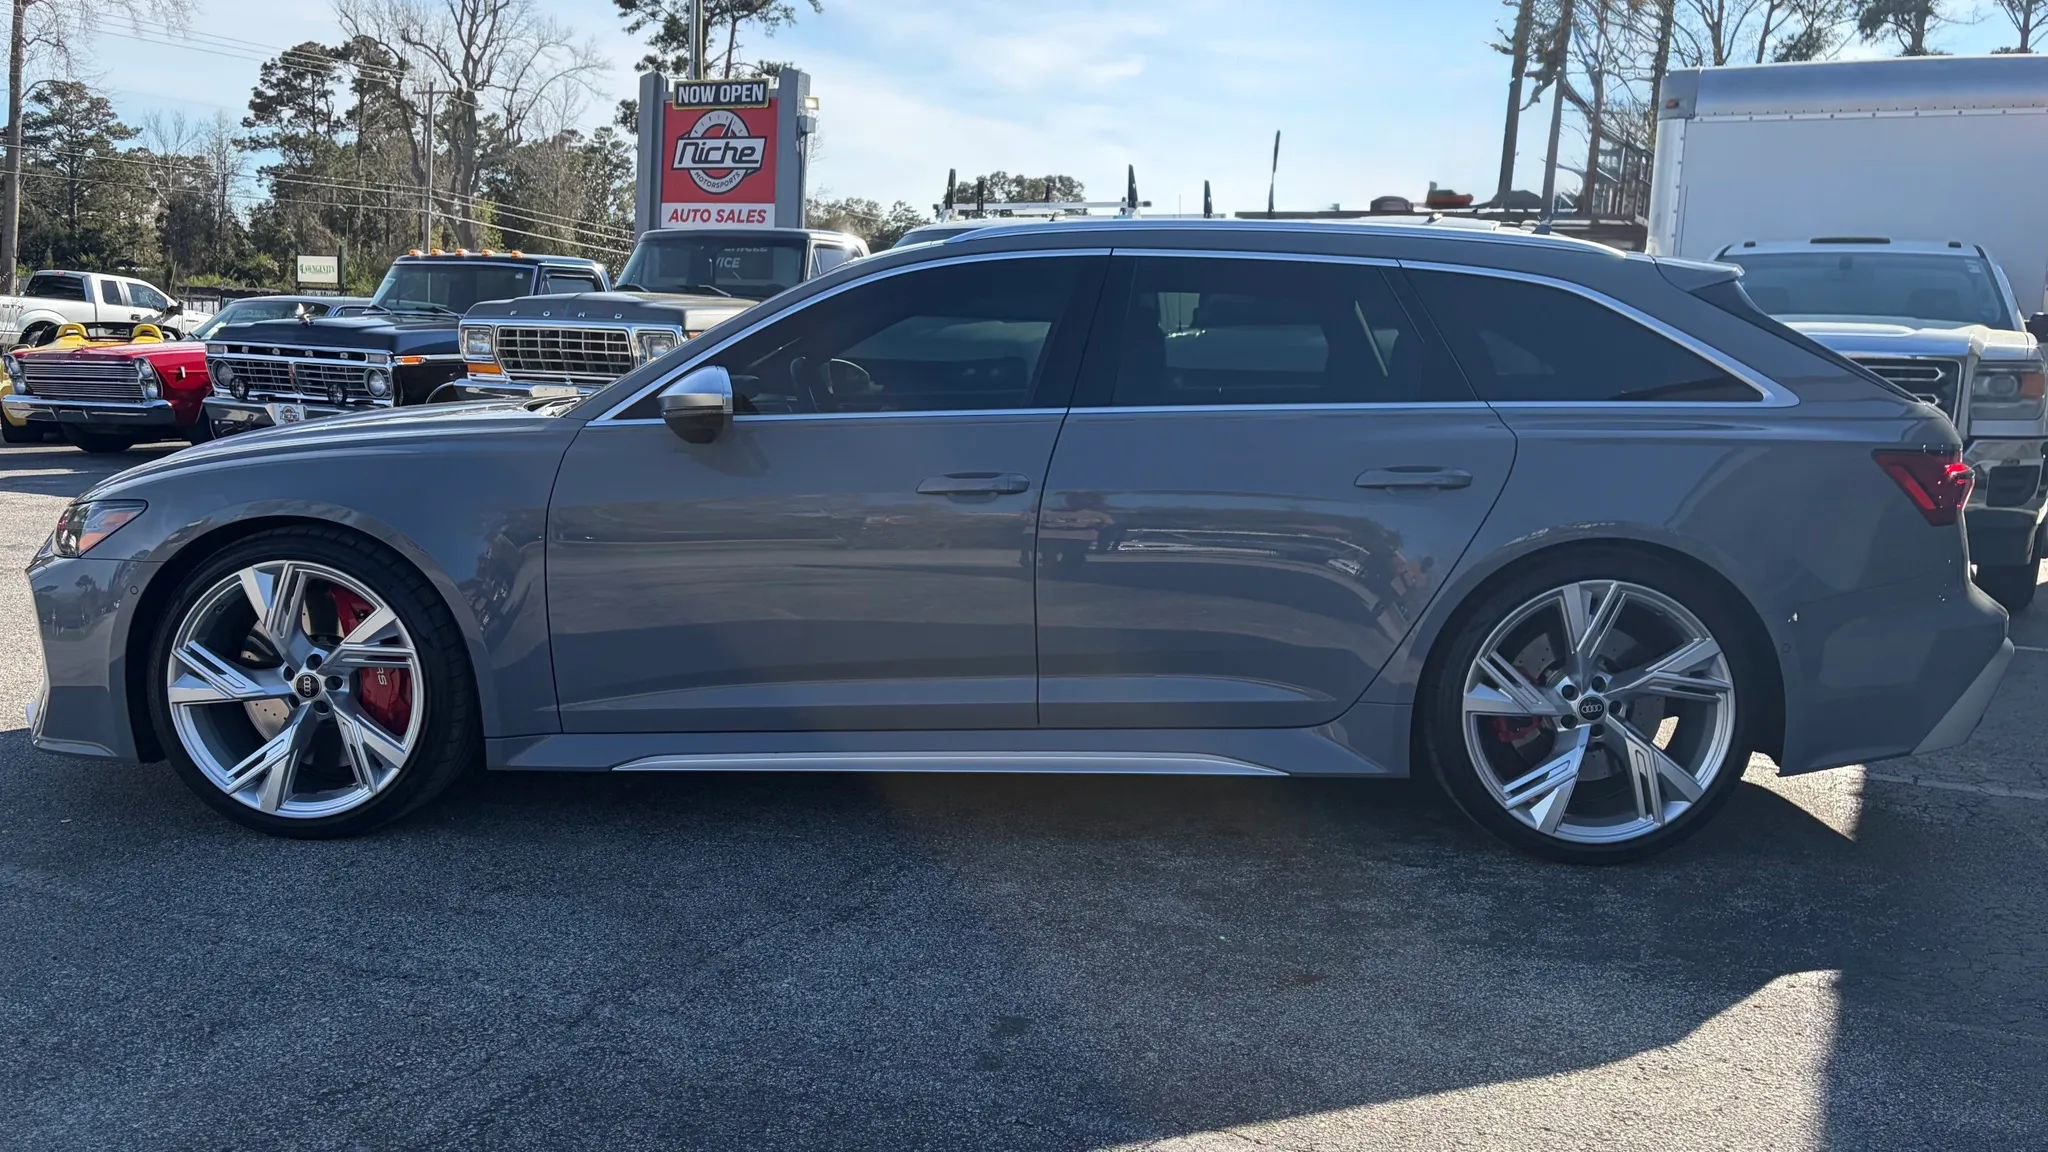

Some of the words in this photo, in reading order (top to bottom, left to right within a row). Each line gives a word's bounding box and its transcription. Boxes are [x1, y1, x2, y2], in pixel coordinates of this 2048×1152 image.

[678, 85, 716, 104] NOW
[720, 83, 764, 102] OPEN
[678, 140, 760, 165] Niche
[694, 171, 741, 188] MOTORSPORTS
[668, 208, 712, 224] AUTO
[715, 208, 767, 224] SALES
